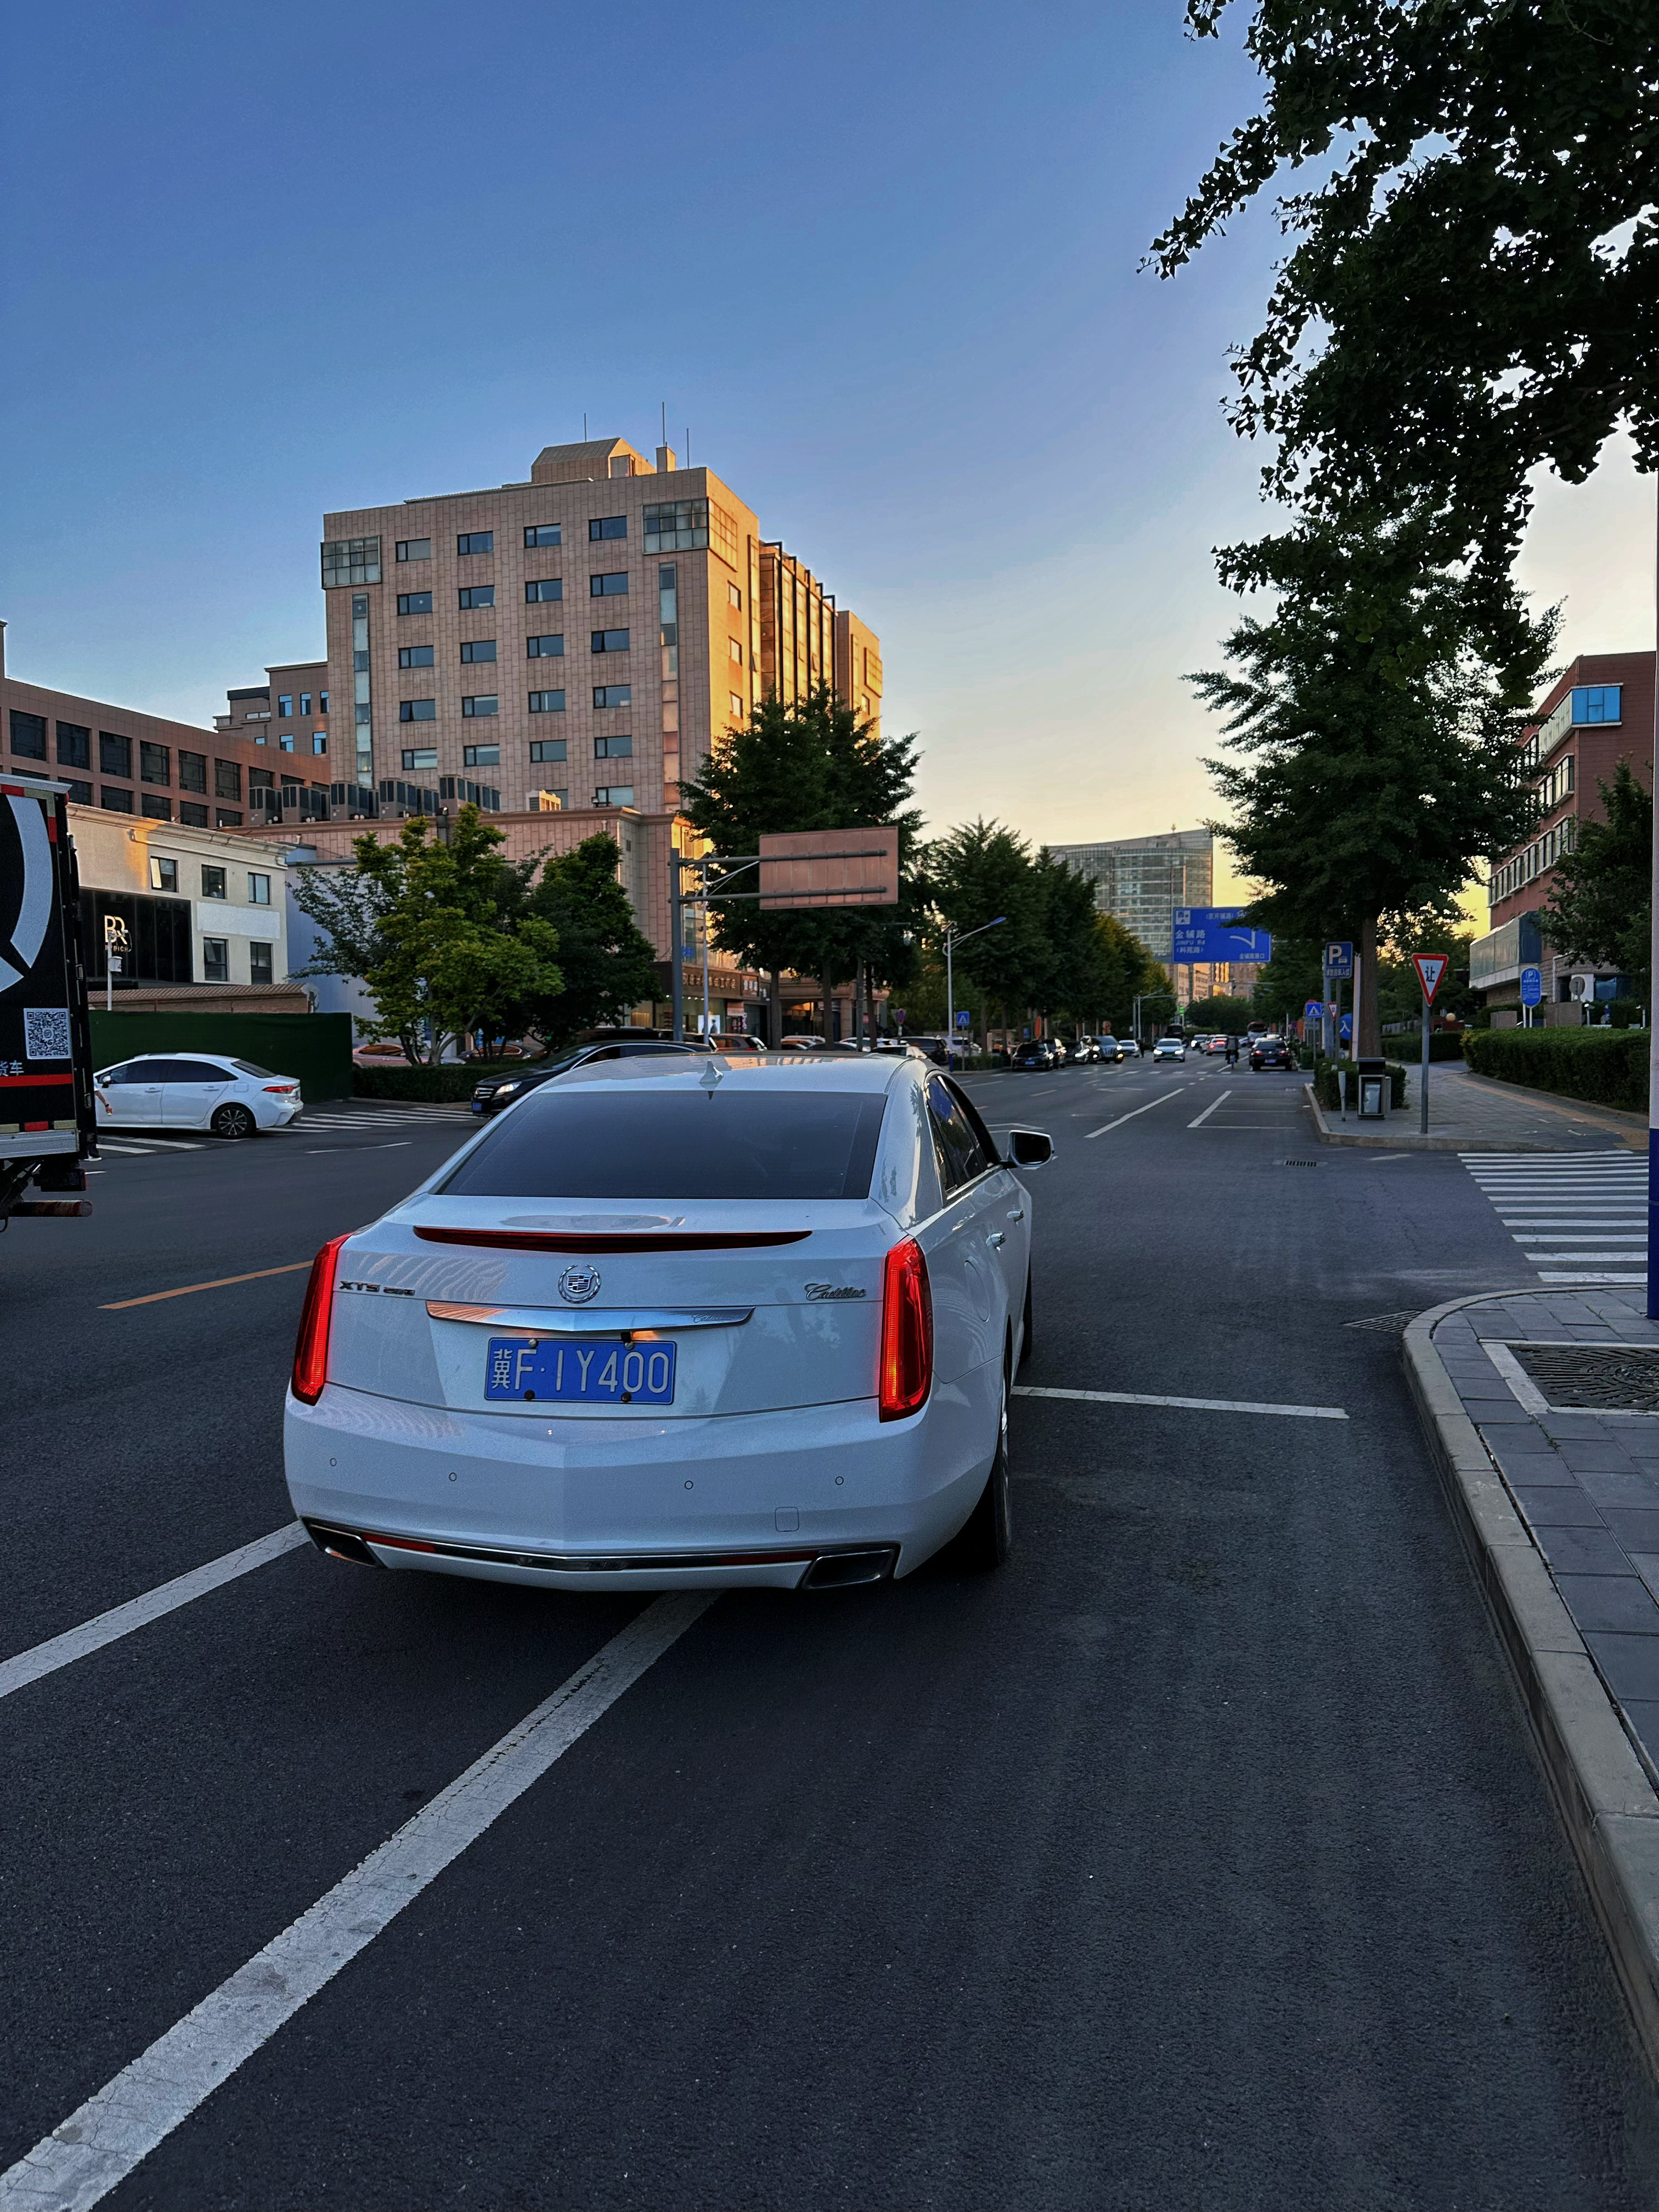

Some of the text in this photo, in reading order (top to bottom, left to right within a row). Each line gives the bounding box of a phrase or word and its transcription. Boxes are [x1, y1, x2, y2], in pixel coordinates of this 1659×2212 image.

[1329, 945, 1342, 964] P
[1425, 966, 1435, 982] 让
[339, 1281, 381, 1293] XTS
[804, 1283, 866, 1301] Cadillac
